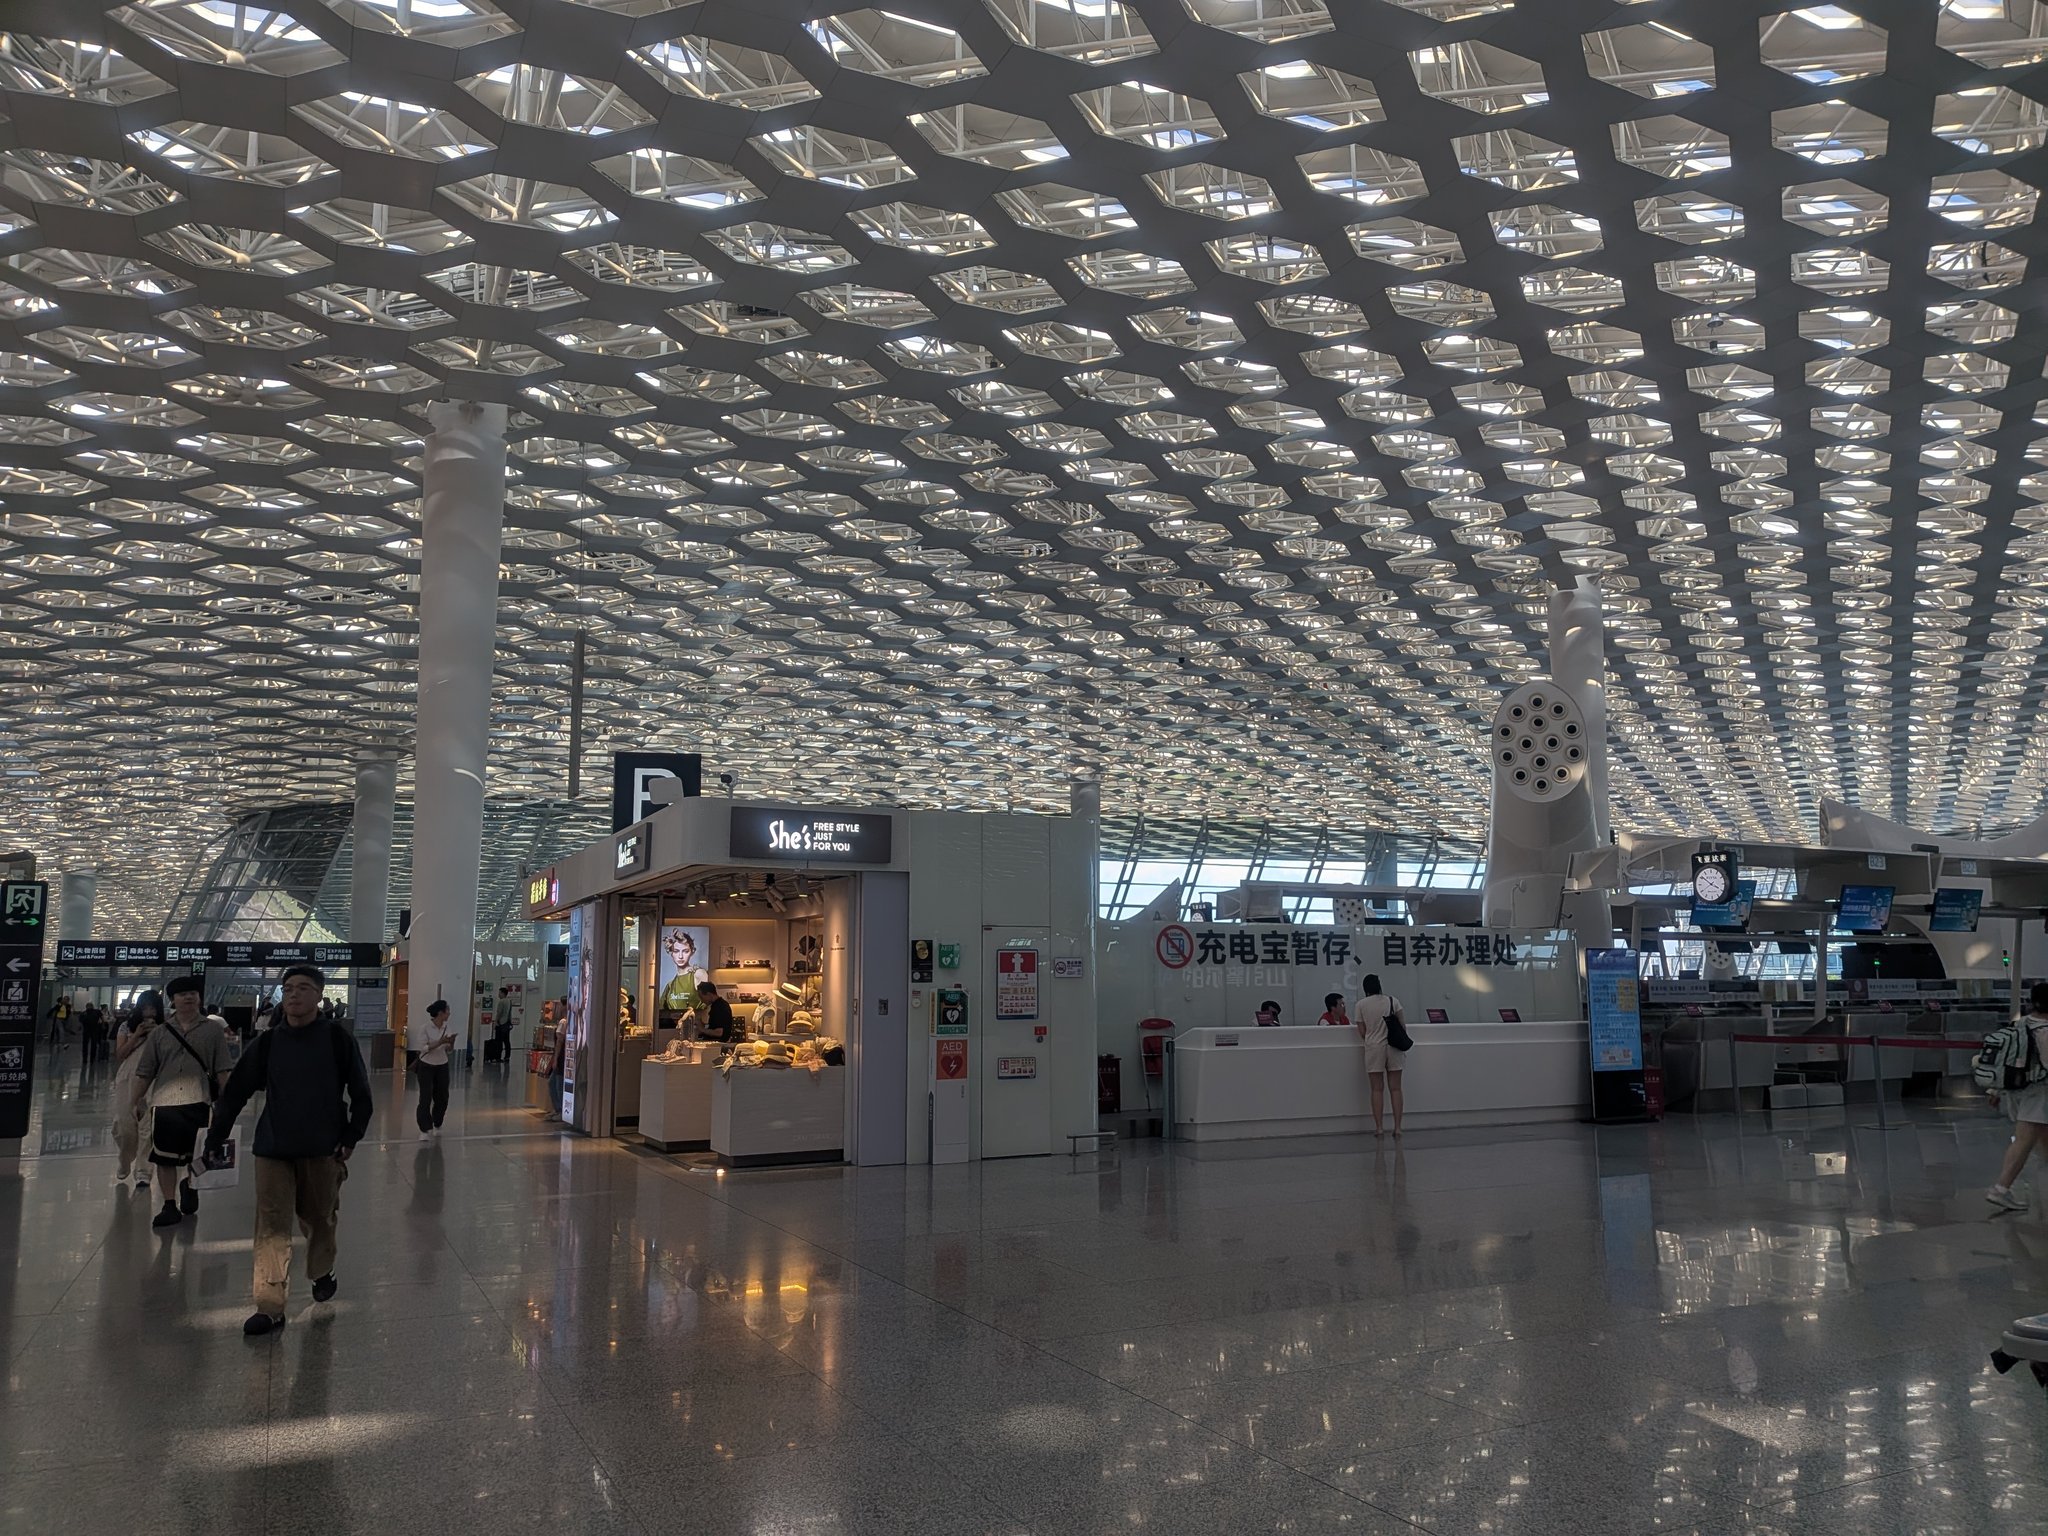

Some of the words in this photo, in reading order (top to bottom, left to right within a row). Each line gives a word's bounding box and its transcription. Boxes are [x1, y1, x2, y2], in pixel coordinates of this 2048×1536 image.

[813, 822, 834, 831] FREE
[835, 823, 860, 832] STYLE
[769, 819, 812, 850] She's
[813, 832, 833, 841] JUST
[813, 842, 831, 851] FOR
[832, 843, 851, 852] YOU
[942, 1042, 963, 1051] AED
